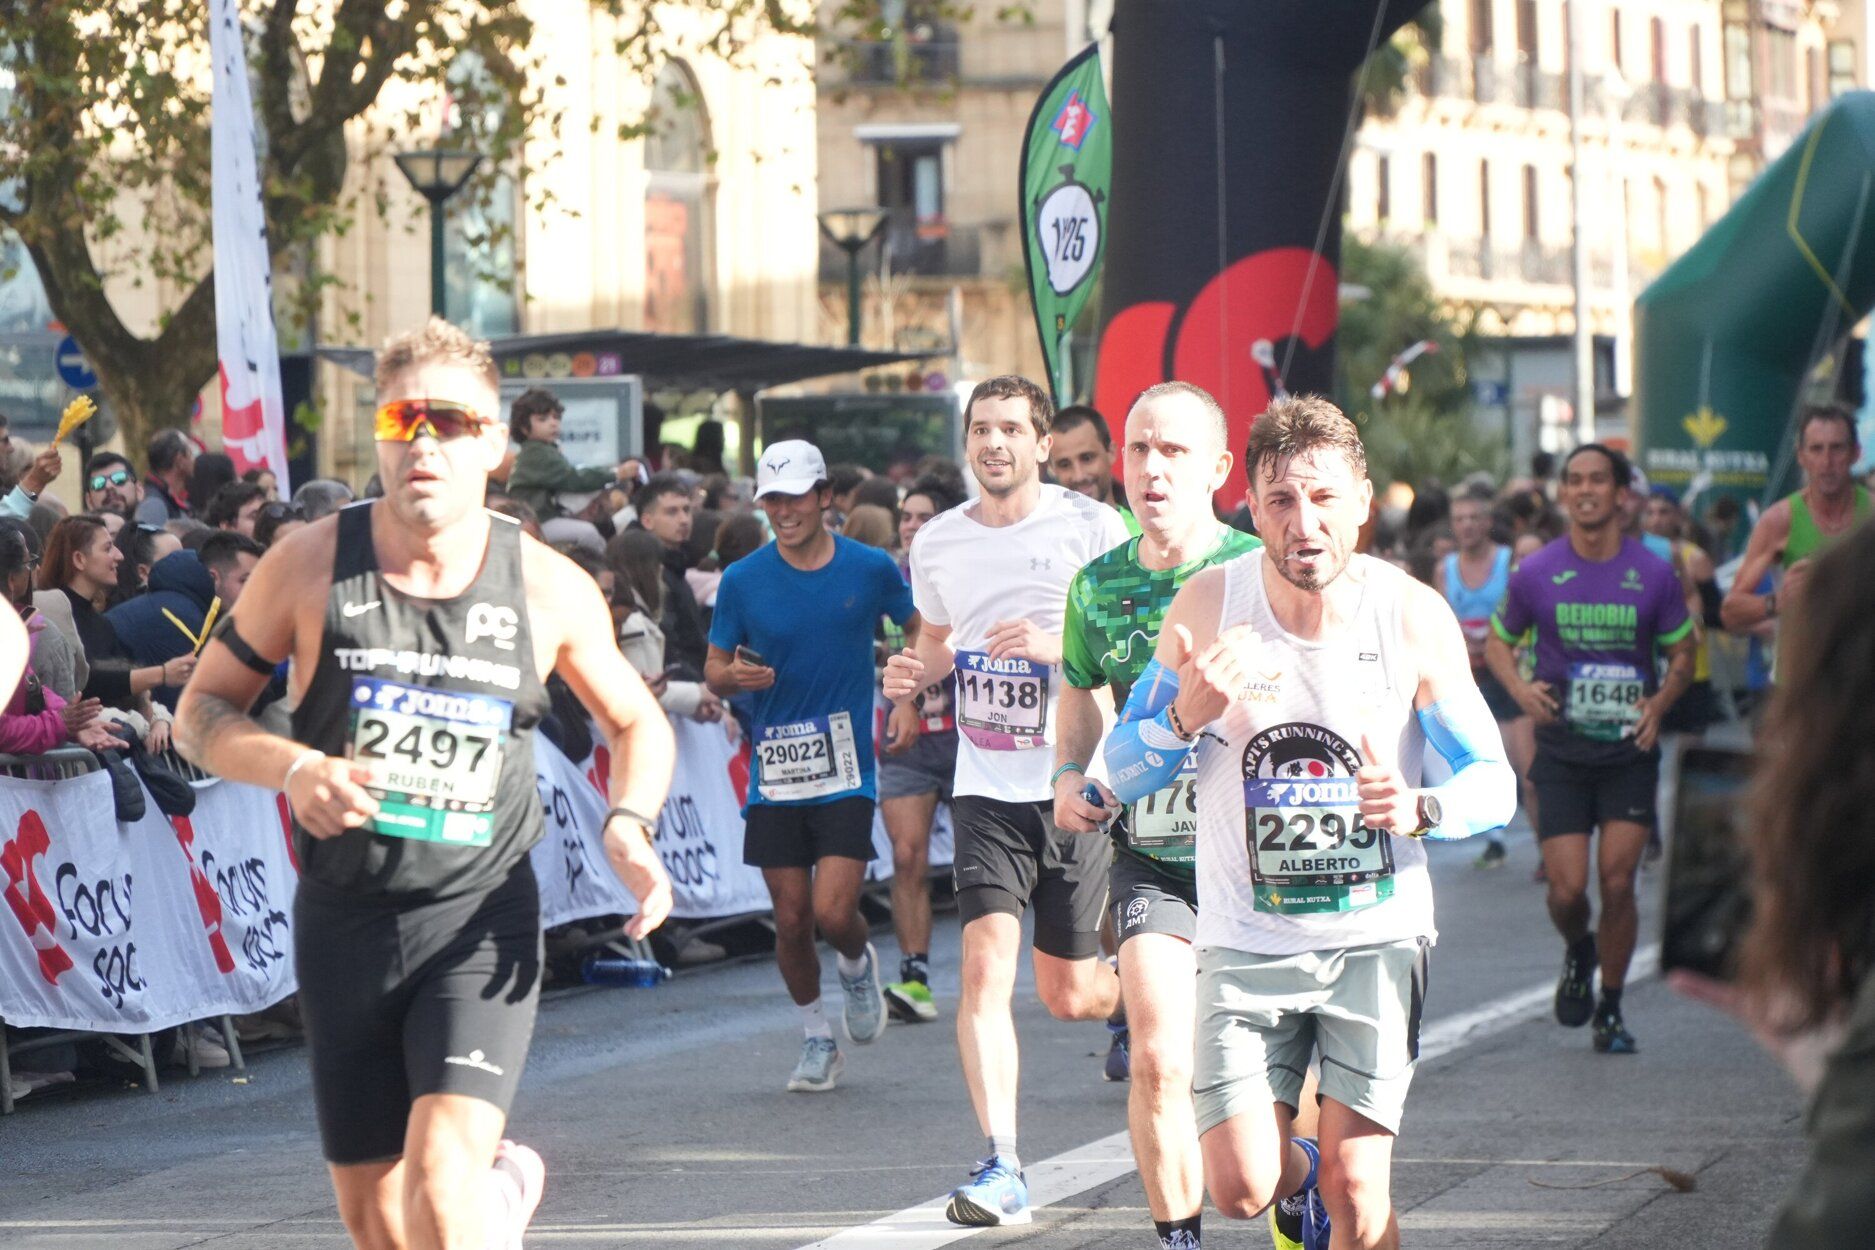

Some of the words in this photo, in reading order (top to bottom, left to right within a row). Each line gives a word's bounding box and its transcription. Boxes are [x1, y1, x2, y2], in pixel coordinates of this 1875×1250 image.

[1555, 603, 1638, 627] BEHOBIA
[966, 675, 1039, 709] 1138
[1575, 684, 1640, 705] 1648
[987, 712, 1008, 724] JON
[359, 719, 492, 773] 2497
[763, 739, 826, 766] 29022
[1244, 736, 1270, 779] API'S
[1268, 726, 1345, 752] RUNNING
[842, 751, 856, 788] 29022
[1258, 813, 1377, 851] 2295
[1279, 856, 1361, 872] ALBERTO
